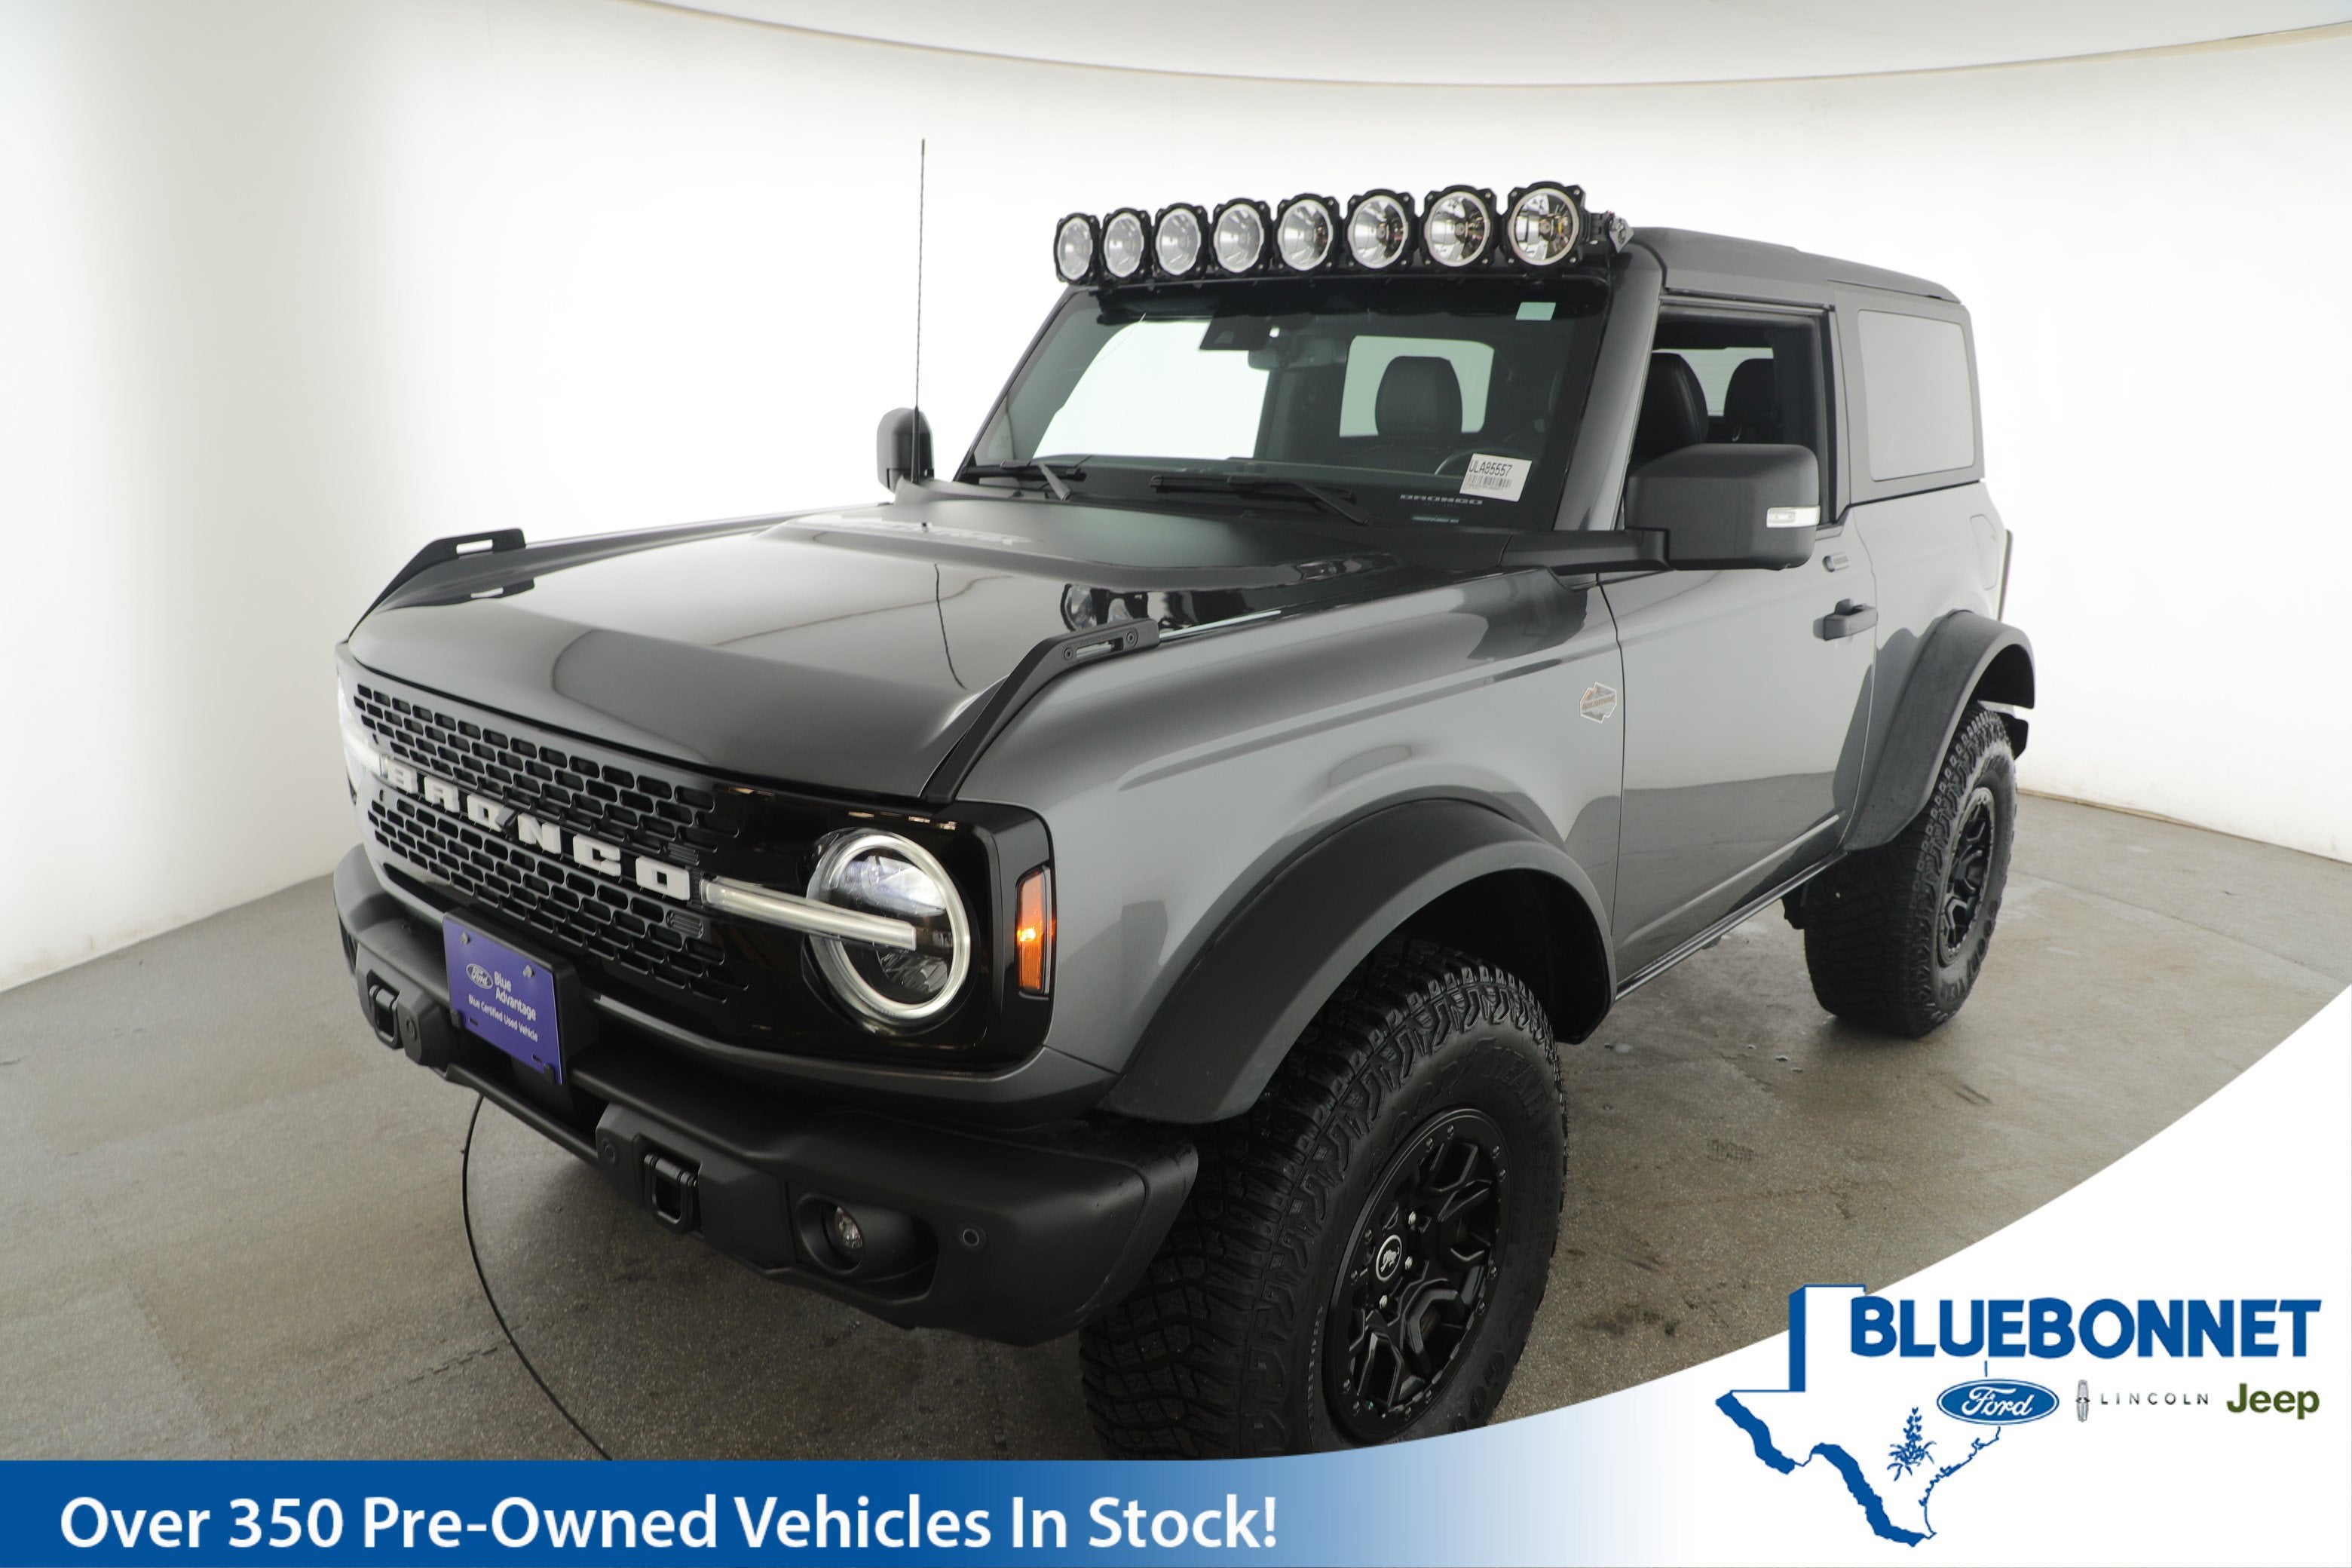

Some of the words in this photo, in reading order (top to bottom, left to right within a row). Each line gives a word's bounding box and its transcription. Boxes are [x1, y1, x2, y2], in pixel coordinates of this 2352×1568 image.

[1468, 459, 1513, 477] ULA85557
[387, 765, 691, 901] BRONCO
[494, 971, 512, 993] Blue
[468, 994, 480, 1009] Blue
[480, 1001, 503, 1022] Certified
[504, 1013, 518, 1031] Used
[518, 1021, 538, 1043] Vehicle
[495, 987, 537, 1021] Advantage
